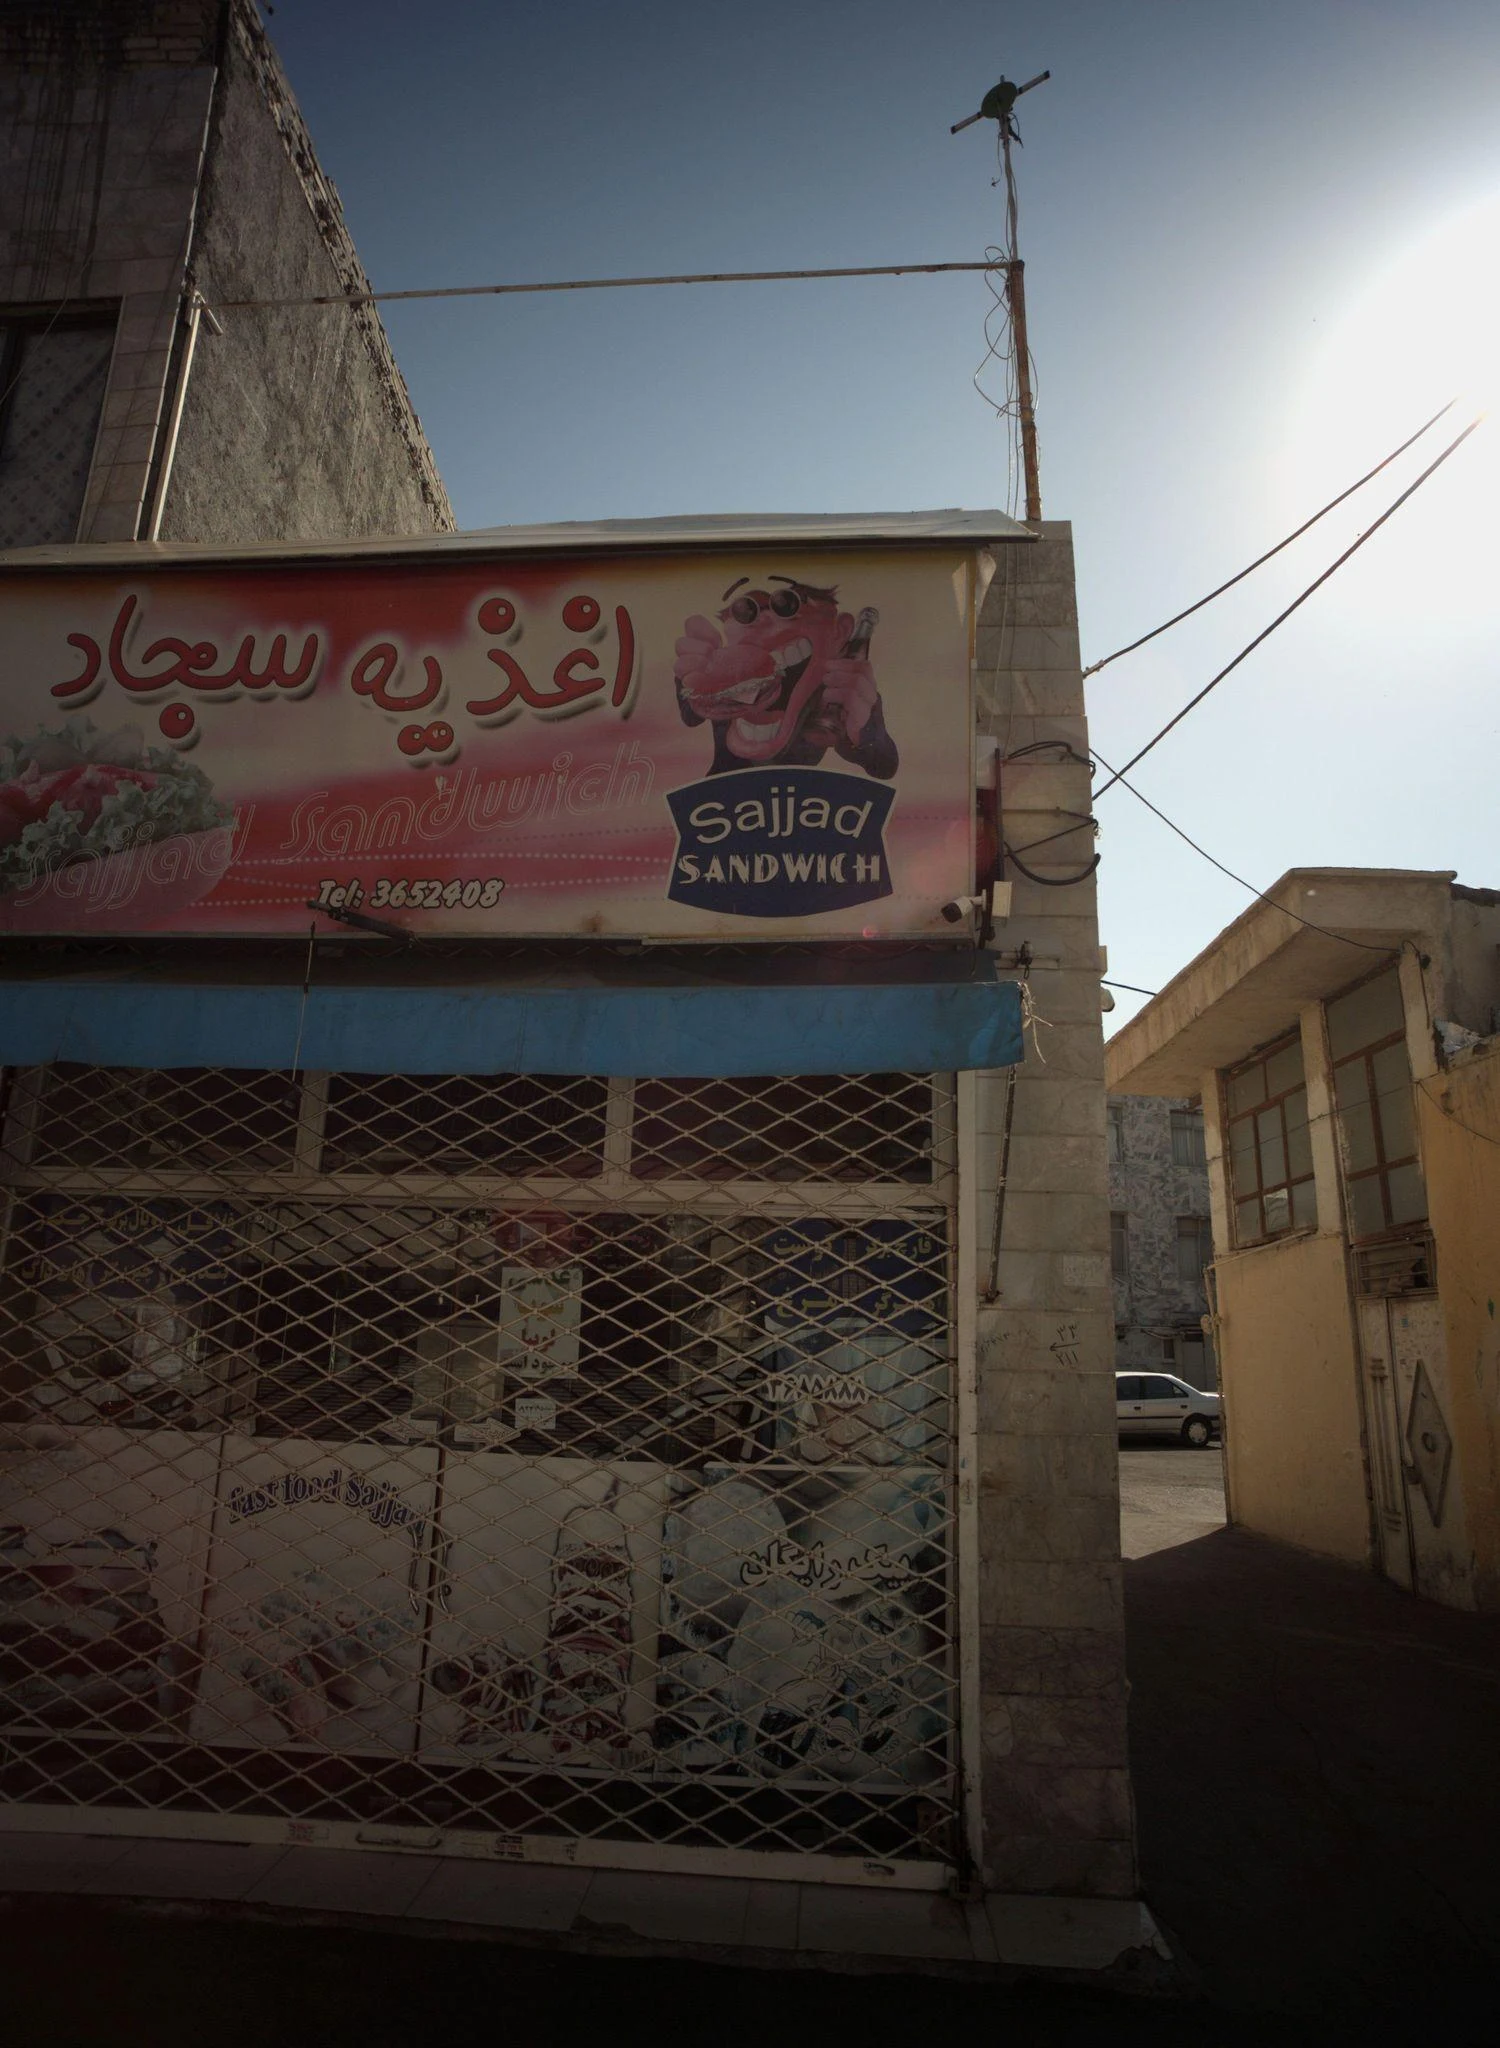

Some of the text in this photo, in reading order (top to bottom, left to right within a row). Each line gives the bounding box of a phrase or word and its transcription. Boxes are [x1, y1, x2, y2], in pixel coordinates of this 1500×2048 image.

[51, 594, 636, 756] اغذیه سجاد
[688, 785, 874, 845] Sajjad
[318, 878, 506, 910] Tel: 3652408
[677, 852, 881, 886] SANDWICH
[344, 1472, 424, 1529] Sajja
